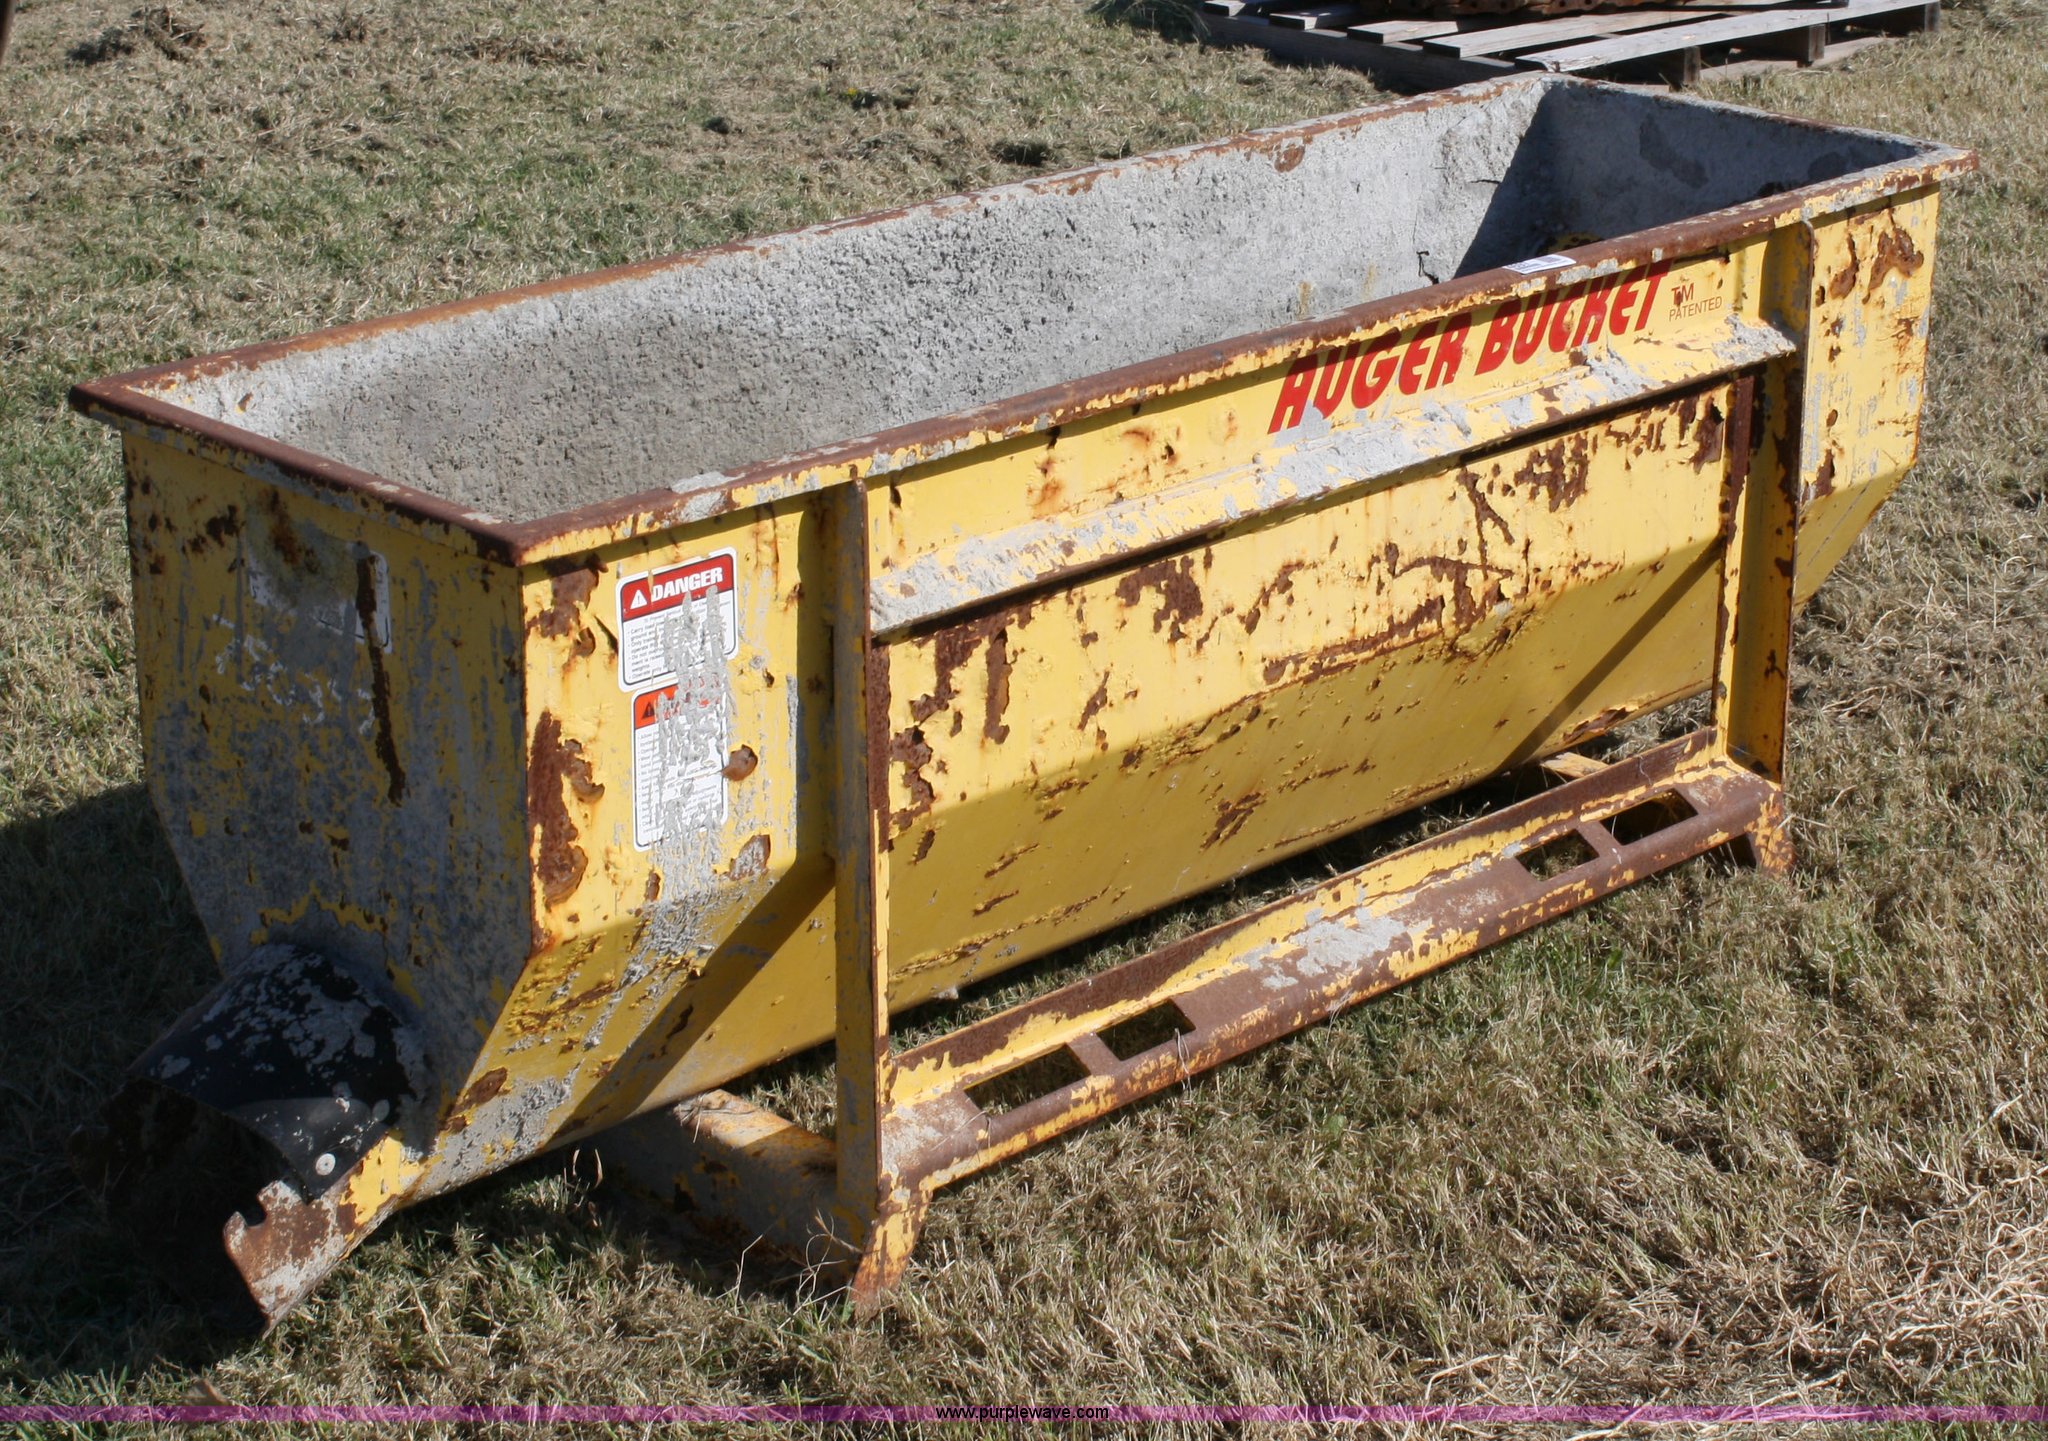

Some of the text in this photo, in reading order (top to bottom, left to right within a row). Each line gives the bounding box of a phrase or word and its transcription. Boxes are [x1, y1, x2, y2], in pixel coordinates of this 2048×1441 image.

[1668, 296, 1722, 322] PATENTED
[1267, 258, 1674, 435] AUGER BUCKET
[651, 567, 723, 603] DANGER
